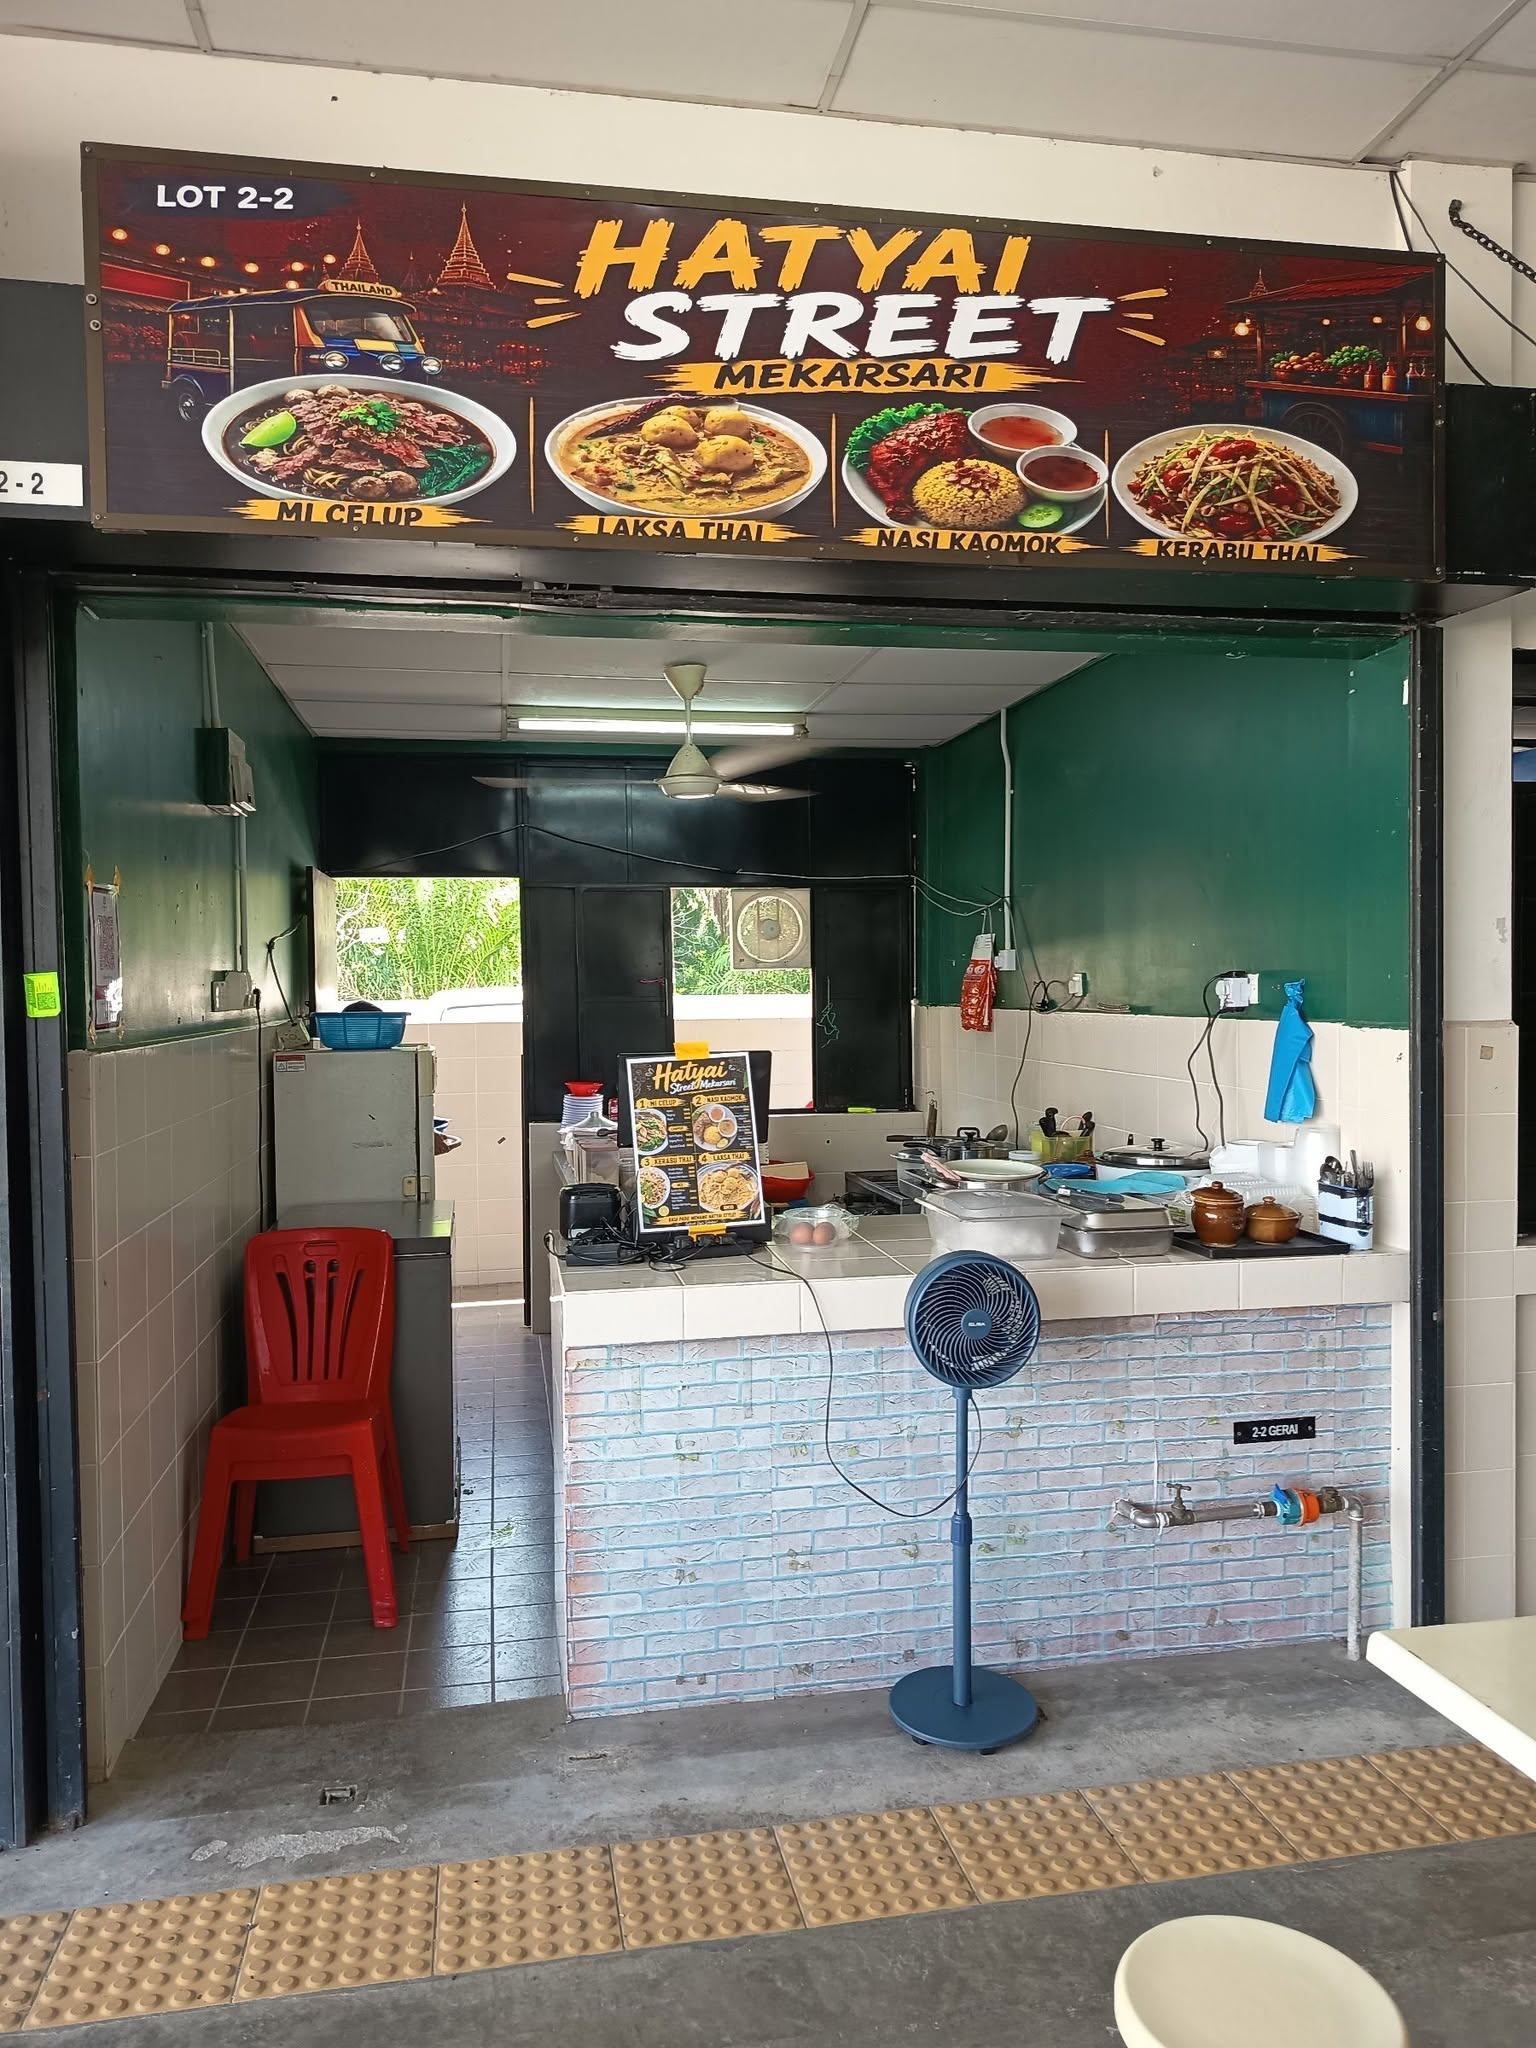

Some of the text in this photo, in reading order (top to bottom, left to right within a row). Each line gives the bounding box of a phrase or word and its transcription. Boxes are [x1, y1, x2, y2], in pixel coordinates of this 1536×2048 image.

[157, 185, 294, 210] LOT 2-2
[574, 217, 1032, 299] HATYAI
[331, 281, 393, 297] THAILAND
[610, 291, 1115, 364] STREET
[714, 362, 988, 389] MEKARSARI
[277, 501, 423, 527] MI CELUP
[597, 516, 764, 542] LAKSA THAI
[877, 529, 1064, 553] NASI KAOMOK
[1156, 540, 1320, 562] KERABU THAI
[652, 1061, 729, 1092] Hatyai
[669, 1082, 697, 1095] Street
[640, 1100, 645, 1109] 1
[695, 1096, 702, 1105] 2
[644, 1158, 650, 1166] 3
[701, 1154, 707, 1162] 4
[1252, 1423, 1299, 1438] 2-2 GERAI
